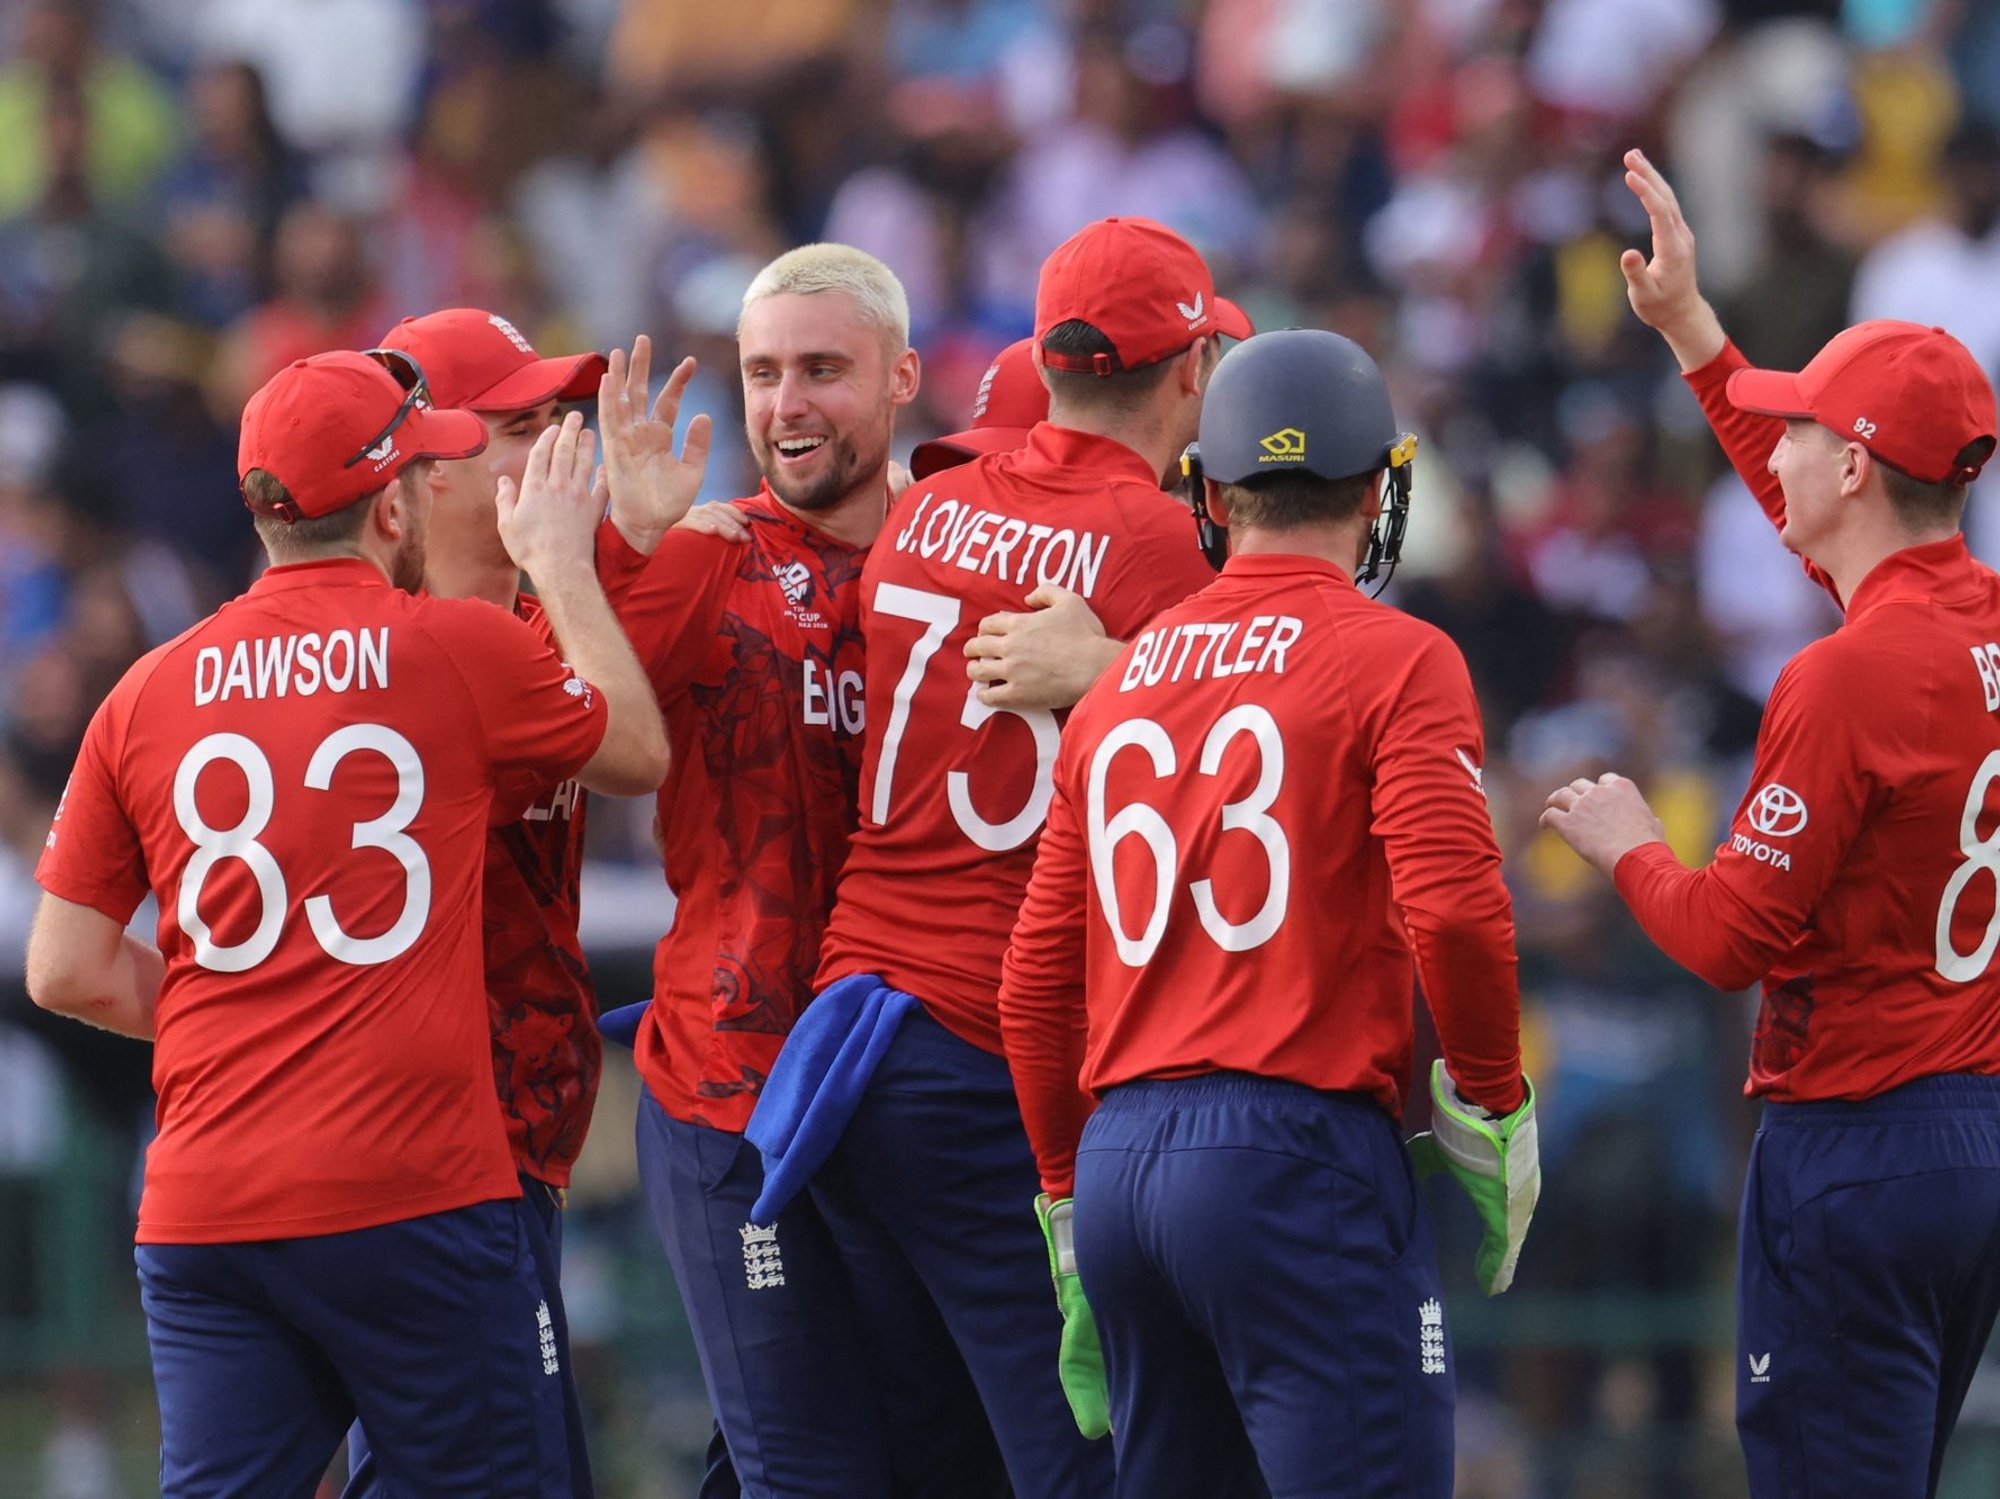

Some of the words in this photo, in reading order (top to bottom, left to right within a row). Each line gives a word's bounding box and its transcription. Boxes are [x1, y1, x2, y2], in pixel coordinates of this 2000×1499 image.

[1258, 455, 1305, 463] MASURI
[1853, 417, 1876, 440] 92
[896, 492, 1110, 599] J.OVERTON
[798, 612, 821, 622] CUP
[1119, 615, 1303, 693] BUTTLER
[195, 627, 389, 707] DAWSON
[173, 723, 432, 973] 83
[1087, 703, 1290, 968] 63
[1732, 833, 1791, 872] TOYOTA
